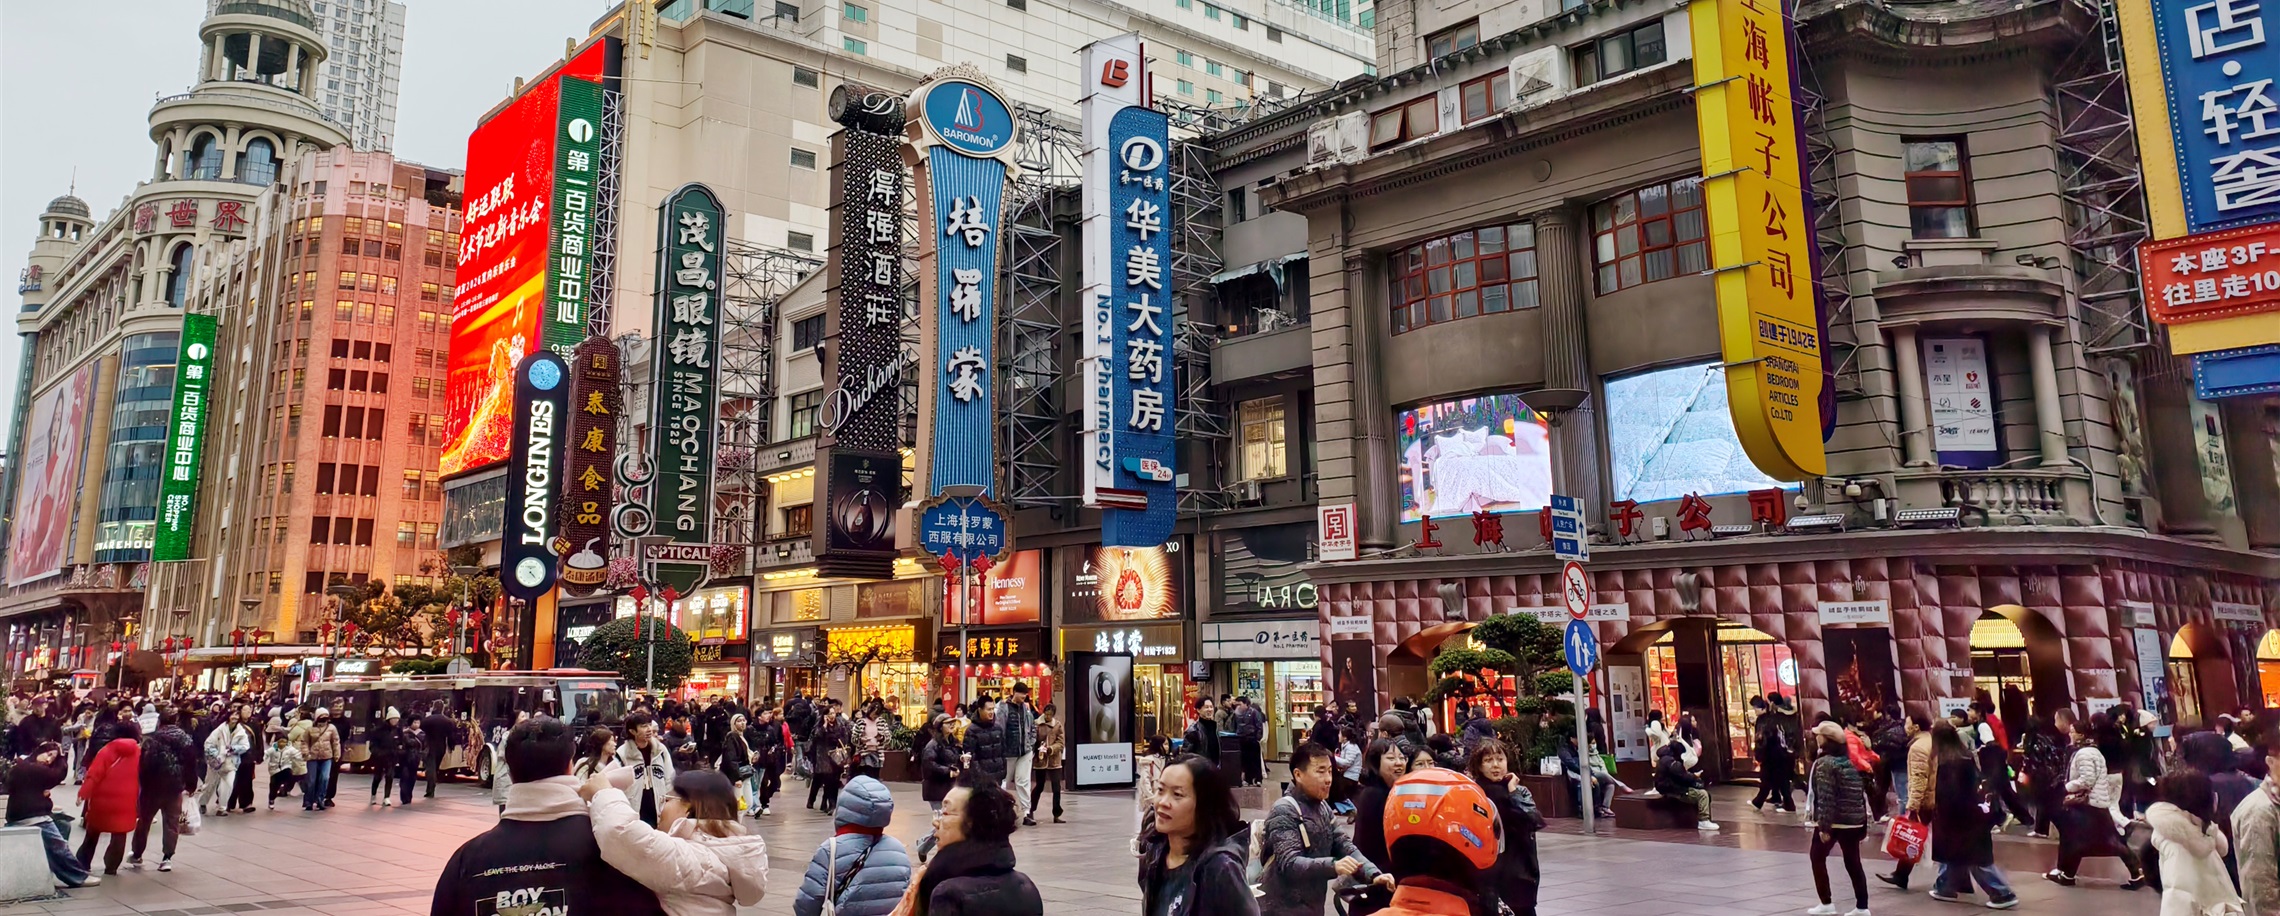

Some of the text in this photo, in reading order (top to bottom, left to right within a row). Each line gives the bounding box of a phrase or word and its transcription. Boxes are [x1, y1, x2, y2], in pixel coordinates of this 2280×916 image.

[943, 127, 994, 149] BAROMON
[135, 199, 249, 233] 新世界
[556, 150, 590, 324] 第一百货商业中心
[668, 211, 714, 369] 茂昌眼镜
[1126, 197, 1165, 431] 华美大药房
[817, 348, 912, 439] Duchamp
[1096, 294, 1113, 473] No.1 Pharmacy
[1767, 372, 1800, 390] BEDROOM
[669, 371, 684, 446] SINCE 1923
[1769, 389, 1799, 407] ARTICLES
[172, 364, 205, 482] 第一百货商业中心
[576, 390, 609, 525] 泰康食品
[676, 372, 703, 532] MAOCHANG
[1141, 460, 1158, 471] 医保
[522, 400, 554, 546] LONGINES
[164, 494, 174, 524] CENTER
[170, 494, 182, 532] SHOPPING
[934, 512, 993, 530] 上海培罗蒙
[646, 545, 710, 560] OPTICAL
[928, 530, 998, 547] 西服有限公司
[1165, 541, 1180, 553] XO
[990, 576, 1026, 590] Hennessy
[483, 861, 556, 877] LEAVE THE BOY ALONE
[496, 886, 545, 909] BOY
